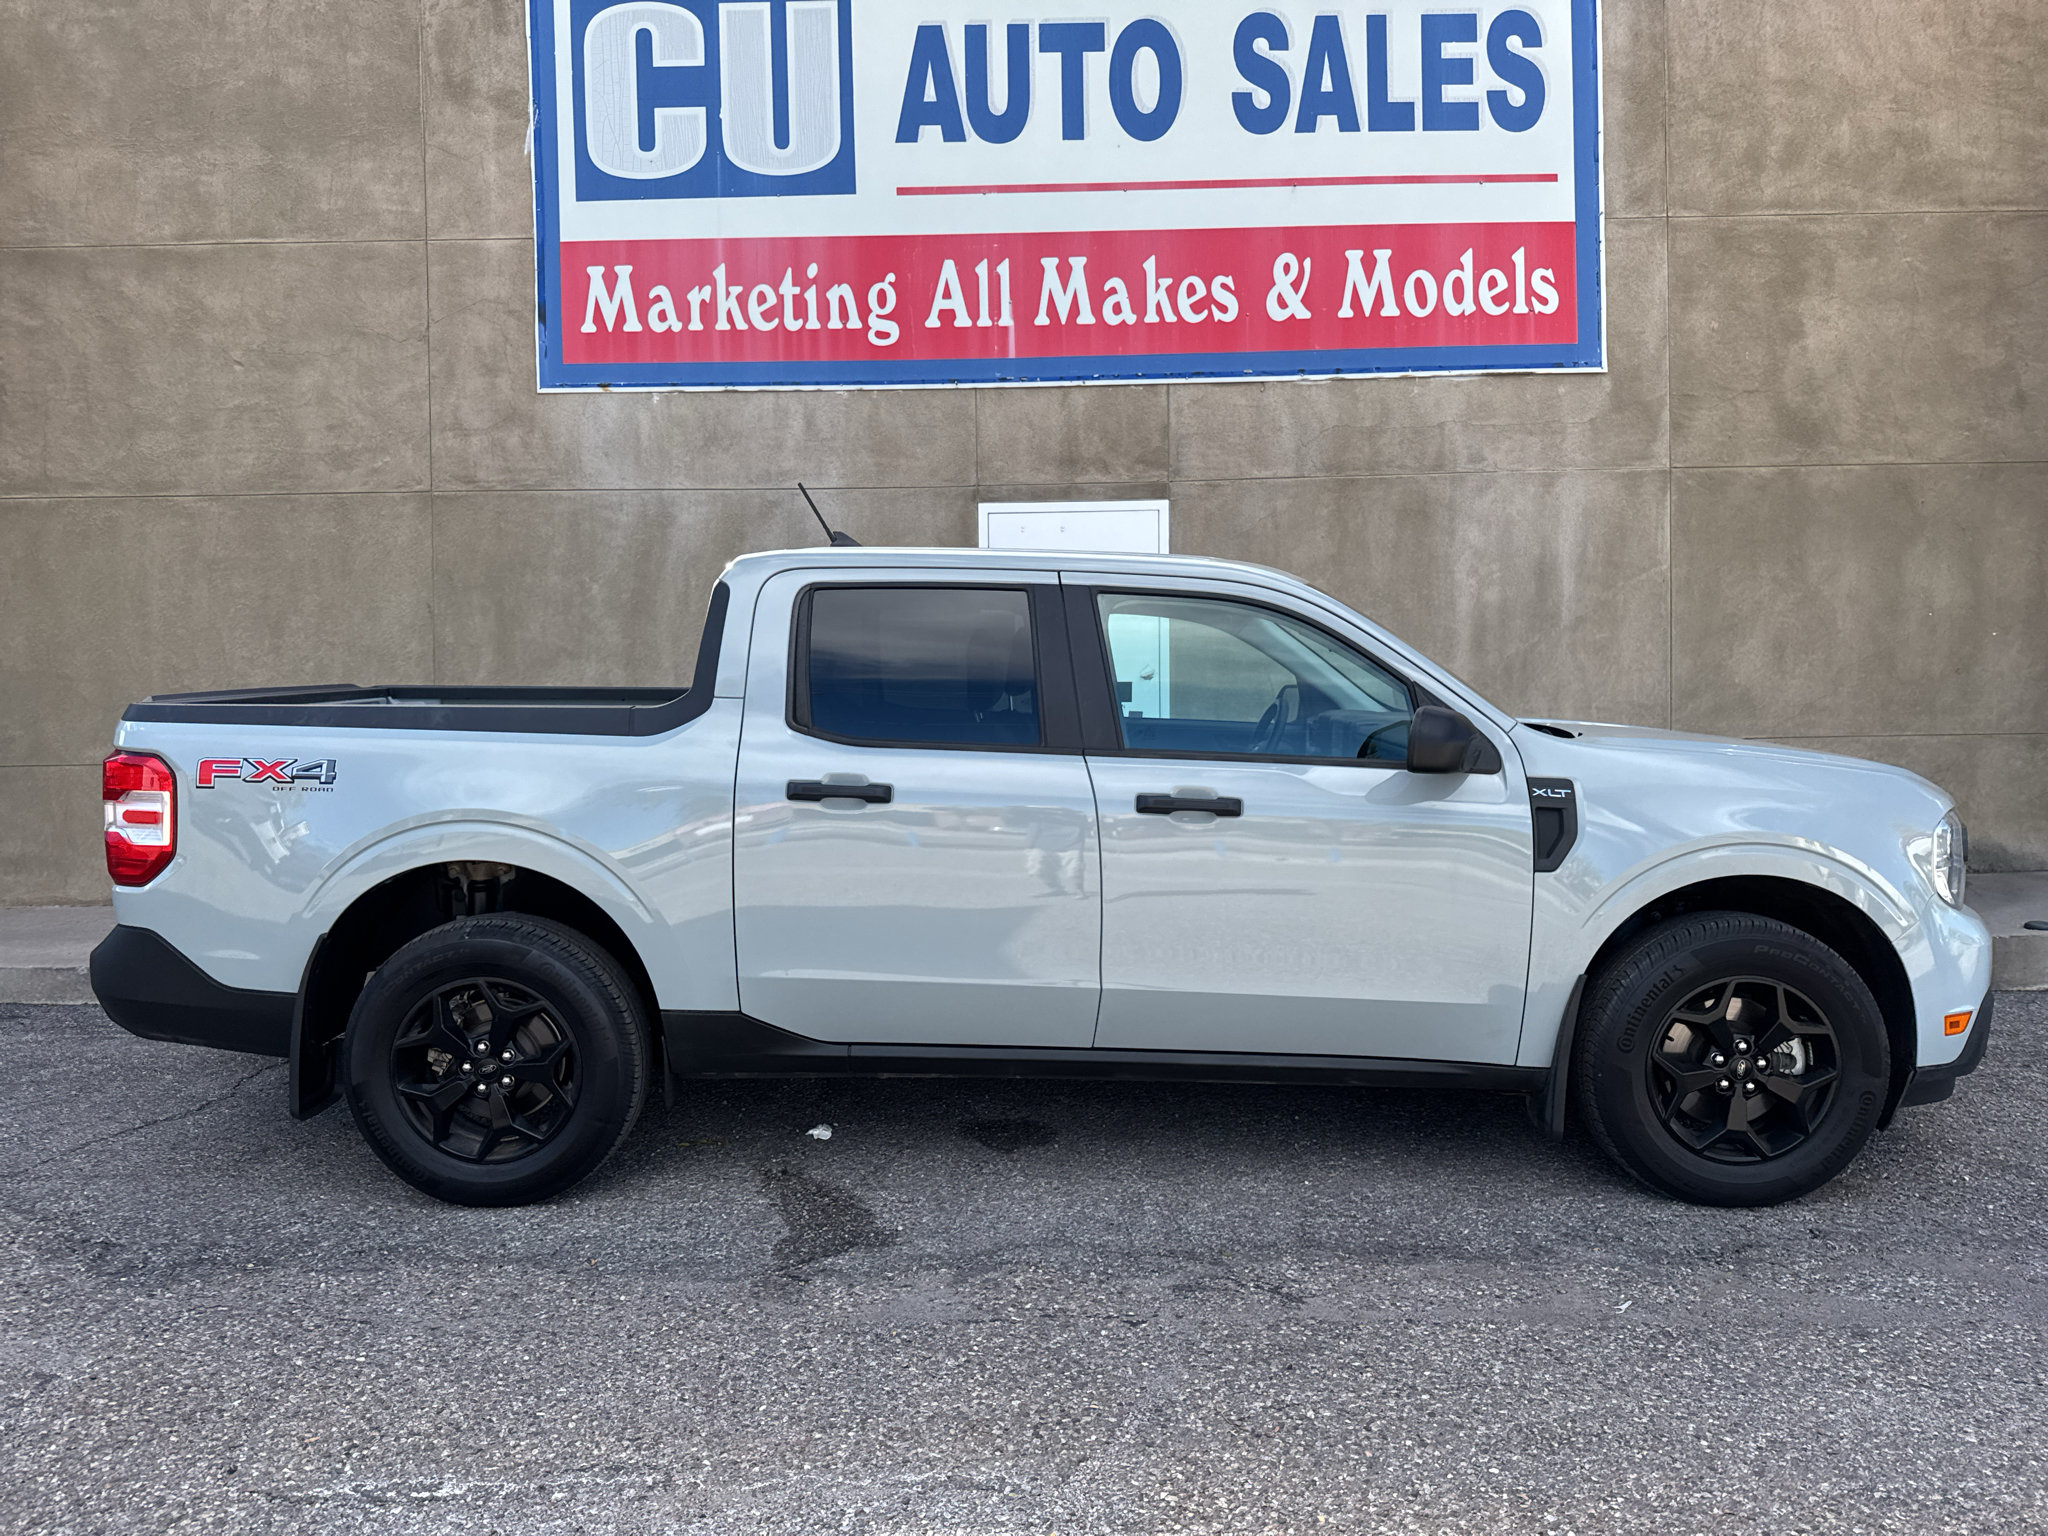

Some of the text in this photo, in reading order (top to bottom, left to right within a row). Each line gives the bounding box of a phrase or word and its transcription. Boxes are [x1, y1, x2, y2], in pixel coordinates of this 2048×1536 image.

[583, 1, 1547, 180] CU AUTO SALES
[581, 246, 1560, 347] Marketing All Makes & Models
[196, 757, 337, 789] FX4
[1532, 787, 1572, 798] XLT
[1616, 970, 1674, 1054] Continental
